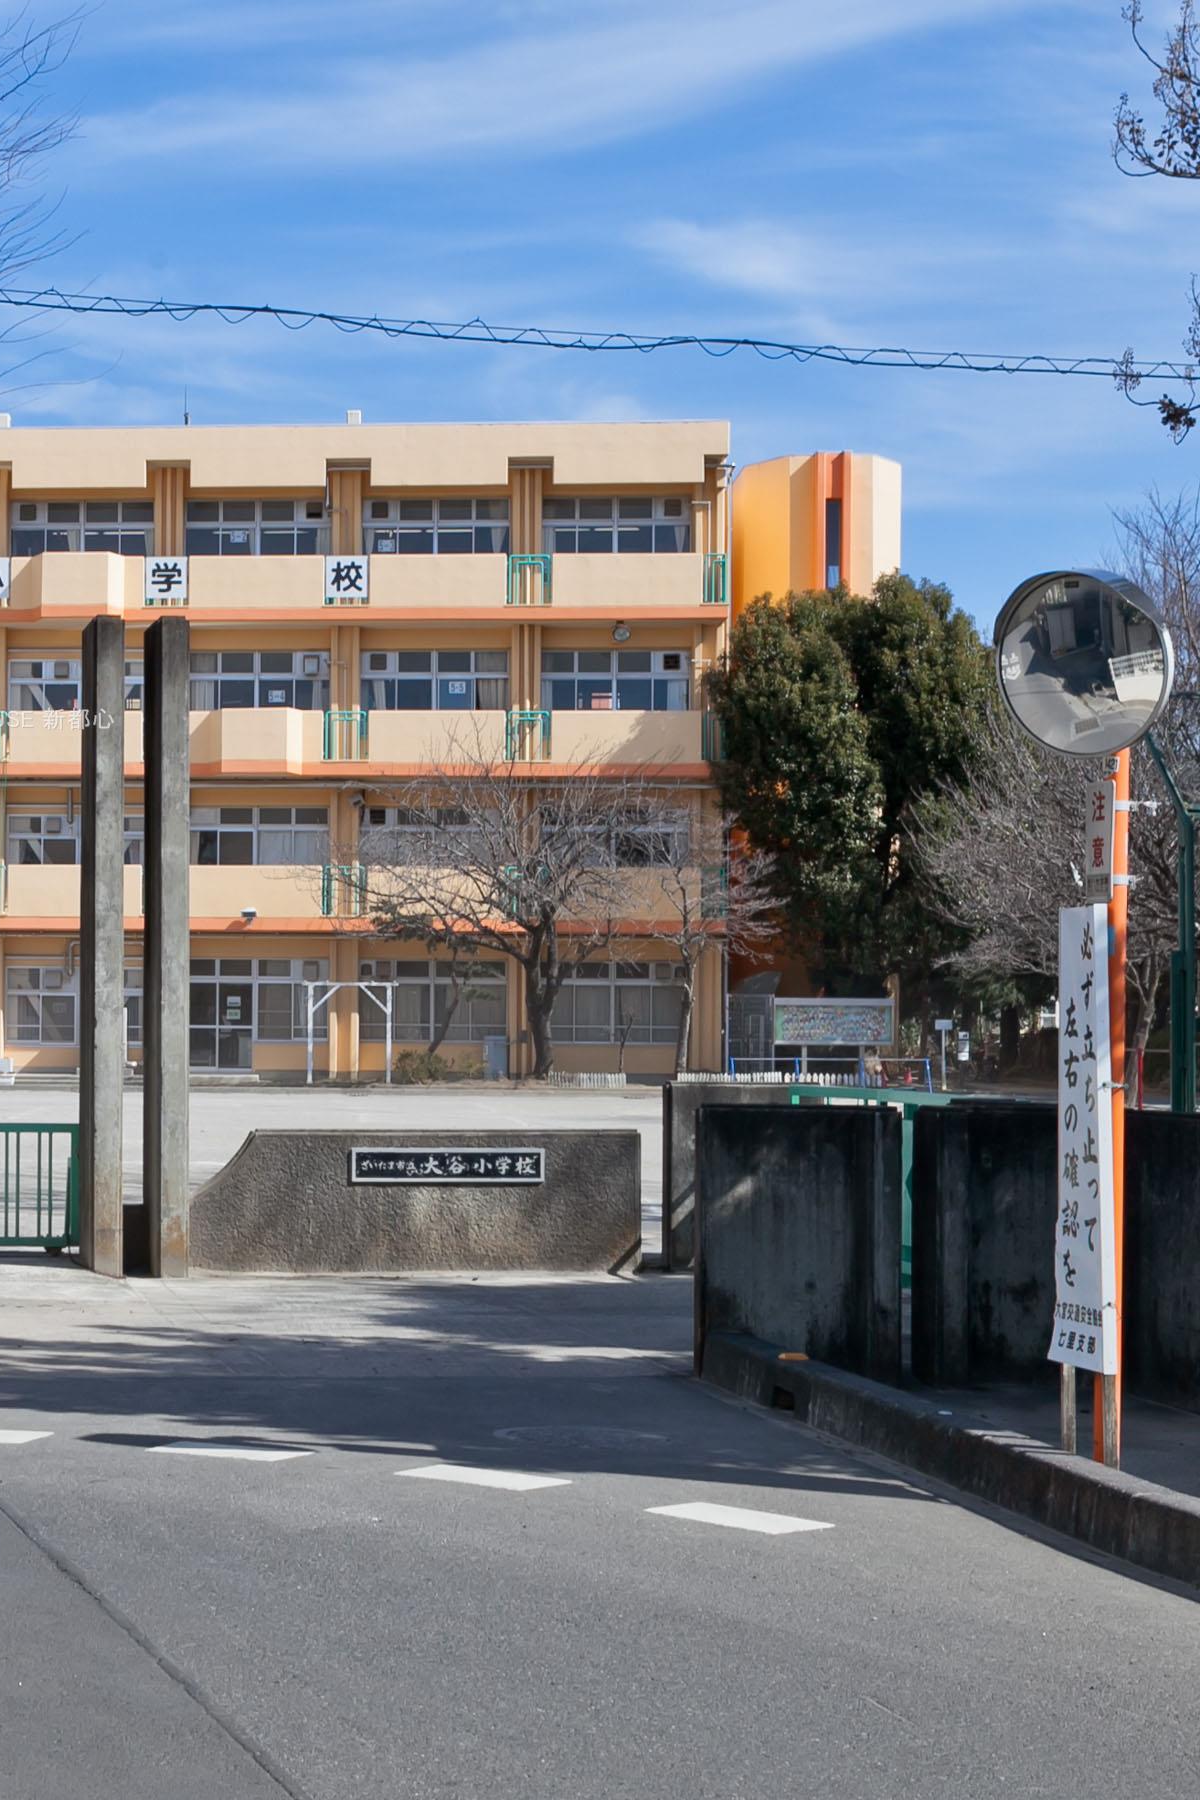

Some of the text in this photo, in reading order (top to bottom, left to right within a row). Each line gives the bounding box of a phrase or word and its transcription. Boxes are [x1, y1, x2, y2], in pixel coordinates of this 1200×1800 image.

[151, 562, 182, 592] 学
[331, 561, 363, 592] 校
[1091, 790, 1106, 868] 注意
[1080, 920, 1099, 1252] 必ず立ち止って
[1062, 997, 1080, 1287] 左右の確認を
[1058, 1330, 1096, 1355] 七里支部
